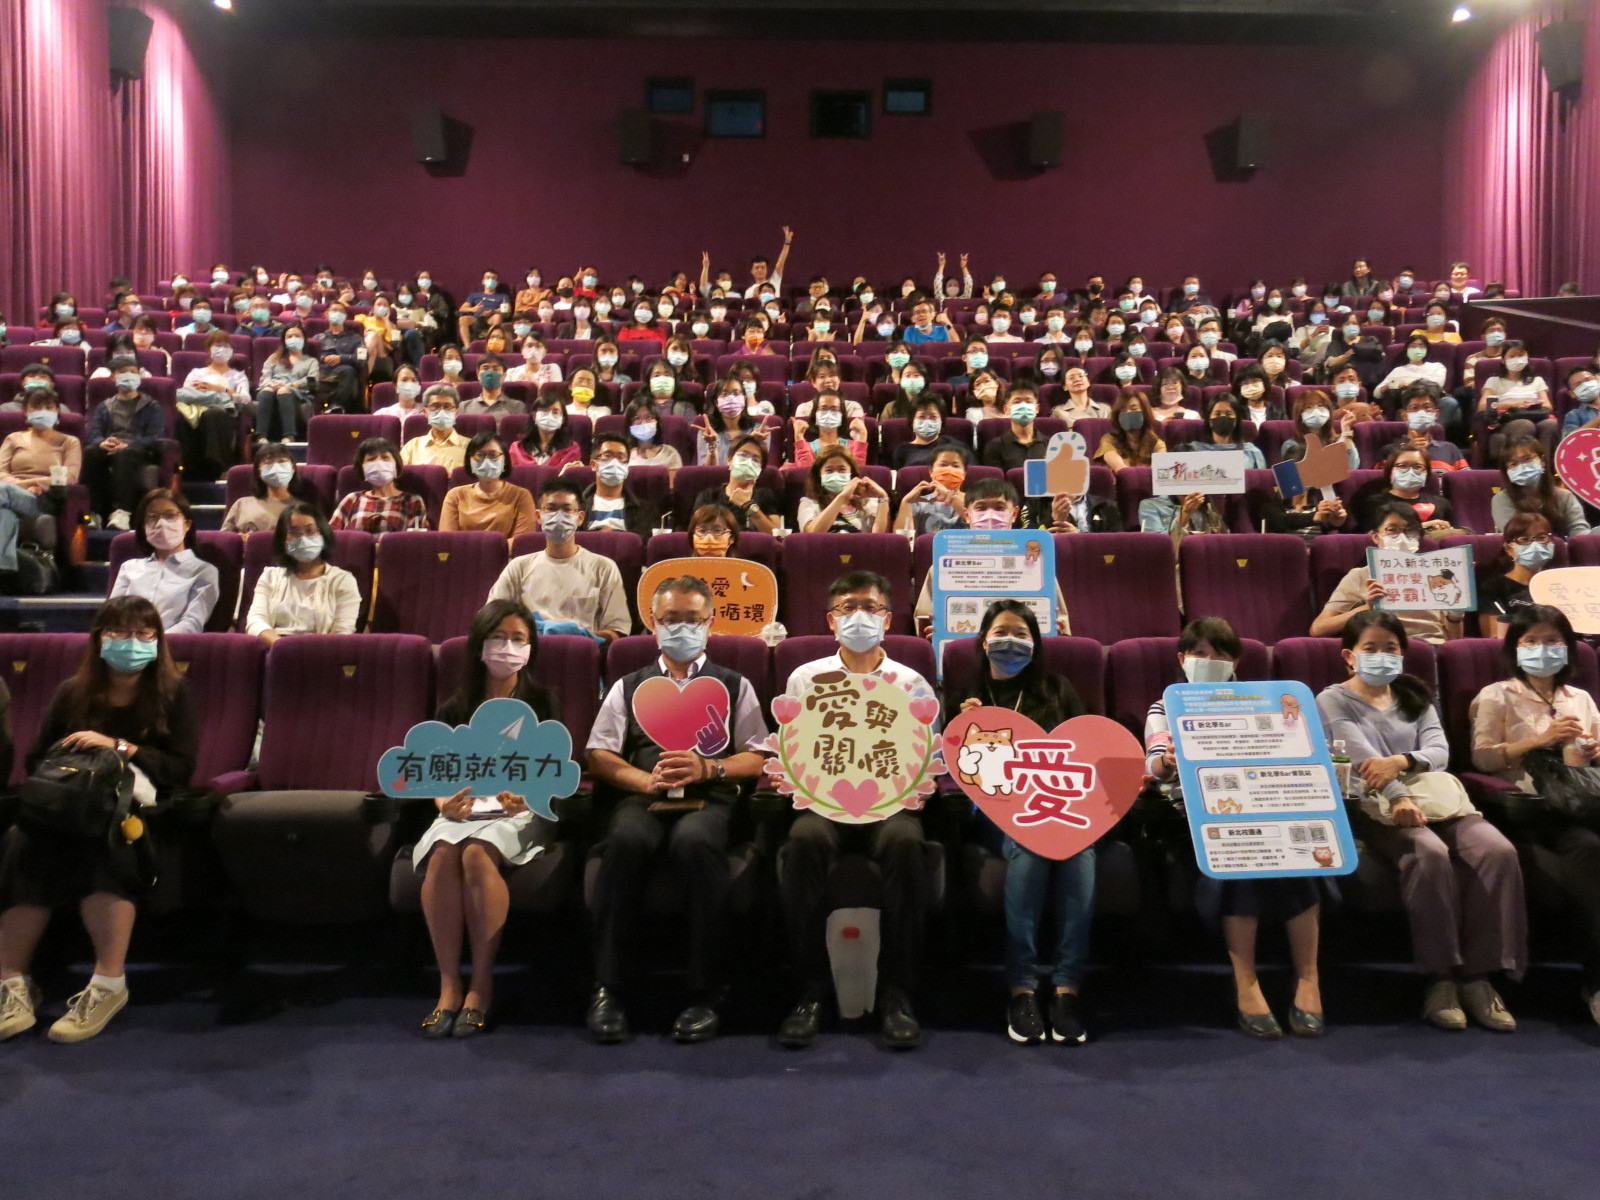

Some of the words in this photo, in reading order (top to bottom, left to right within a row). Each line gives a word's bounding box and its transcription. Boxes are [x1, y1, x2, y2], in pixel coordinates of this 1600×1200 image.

[1380, 557, 1463, 569] 加入新北市Bar
[1382, 573, 1423, 585] 讓你變
[806, 670, 899, 734] 愛與
[396, 751, 562, 783] 有願就有力
[813, 734, 900, 779] 關懷
[1004, 739, 1095, 829] 愛
